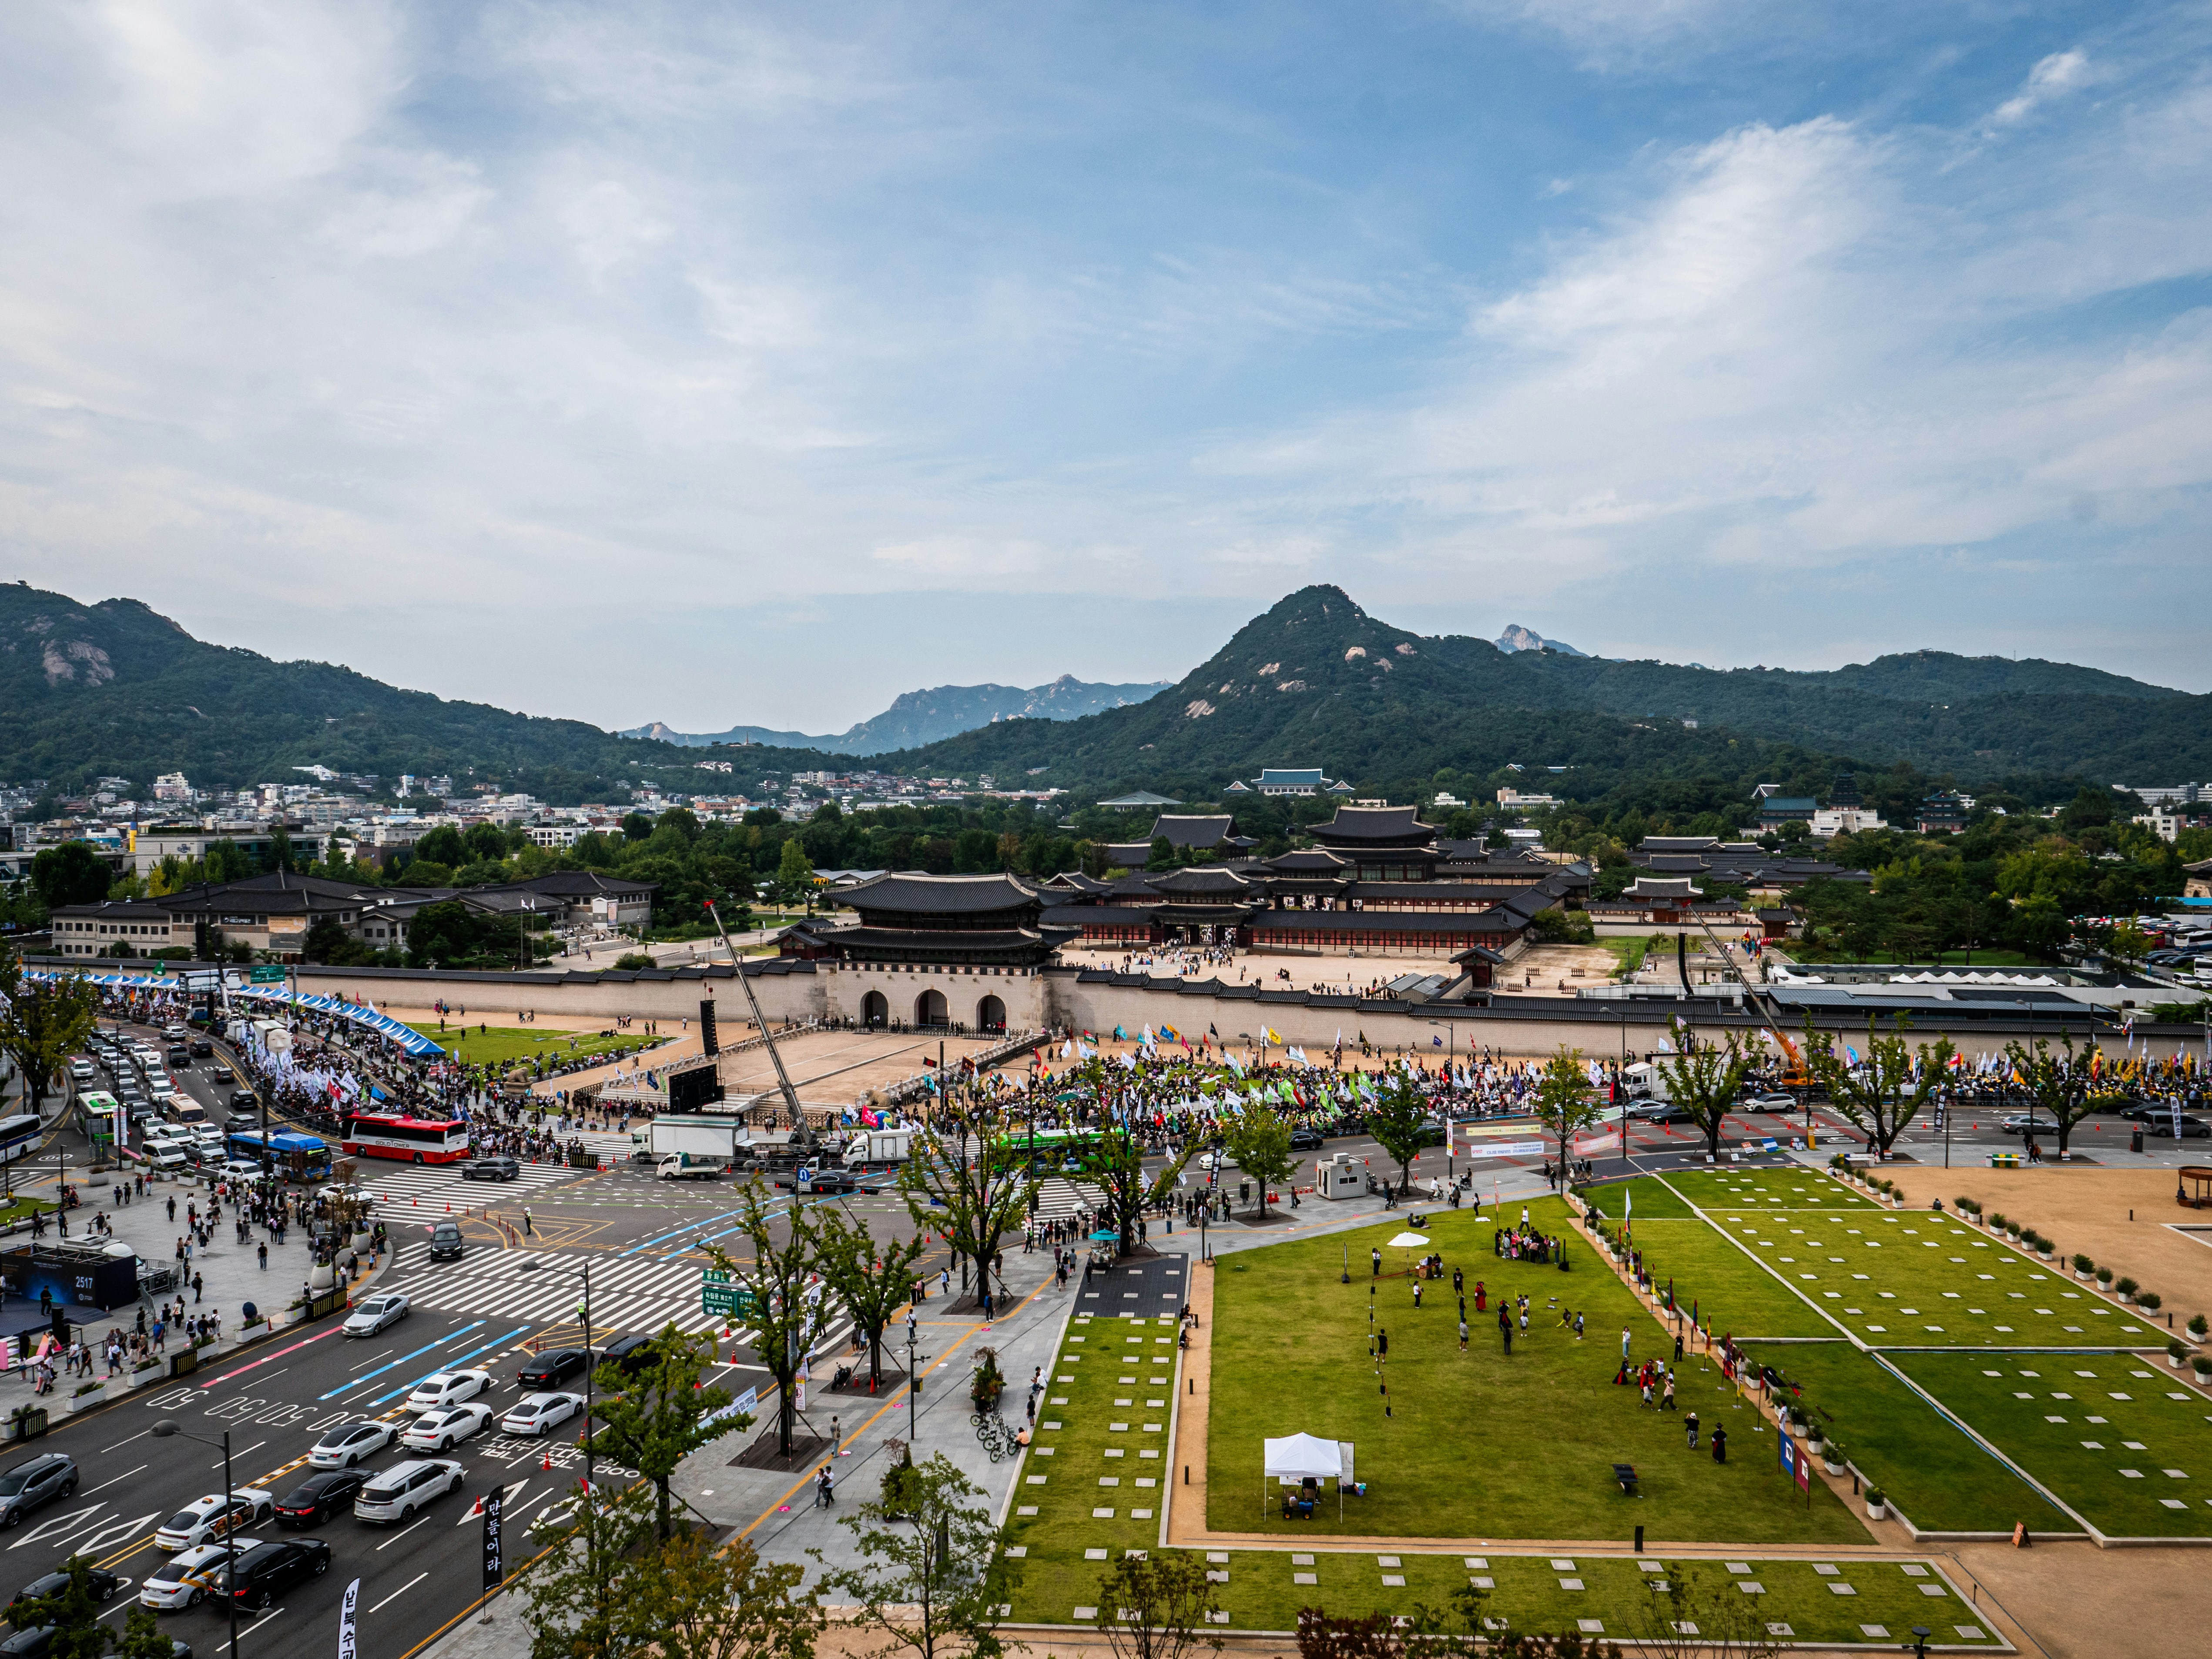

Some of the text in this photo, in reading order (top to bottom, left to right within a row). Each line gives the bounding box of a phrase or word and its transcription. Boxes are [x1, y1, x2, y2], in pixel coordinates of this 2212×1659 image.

[75, 1276, 93, 1289] 2517
[705, 1292, 719, 1300] 독립문
[487, 1499, 502, 1572] 만들어라
